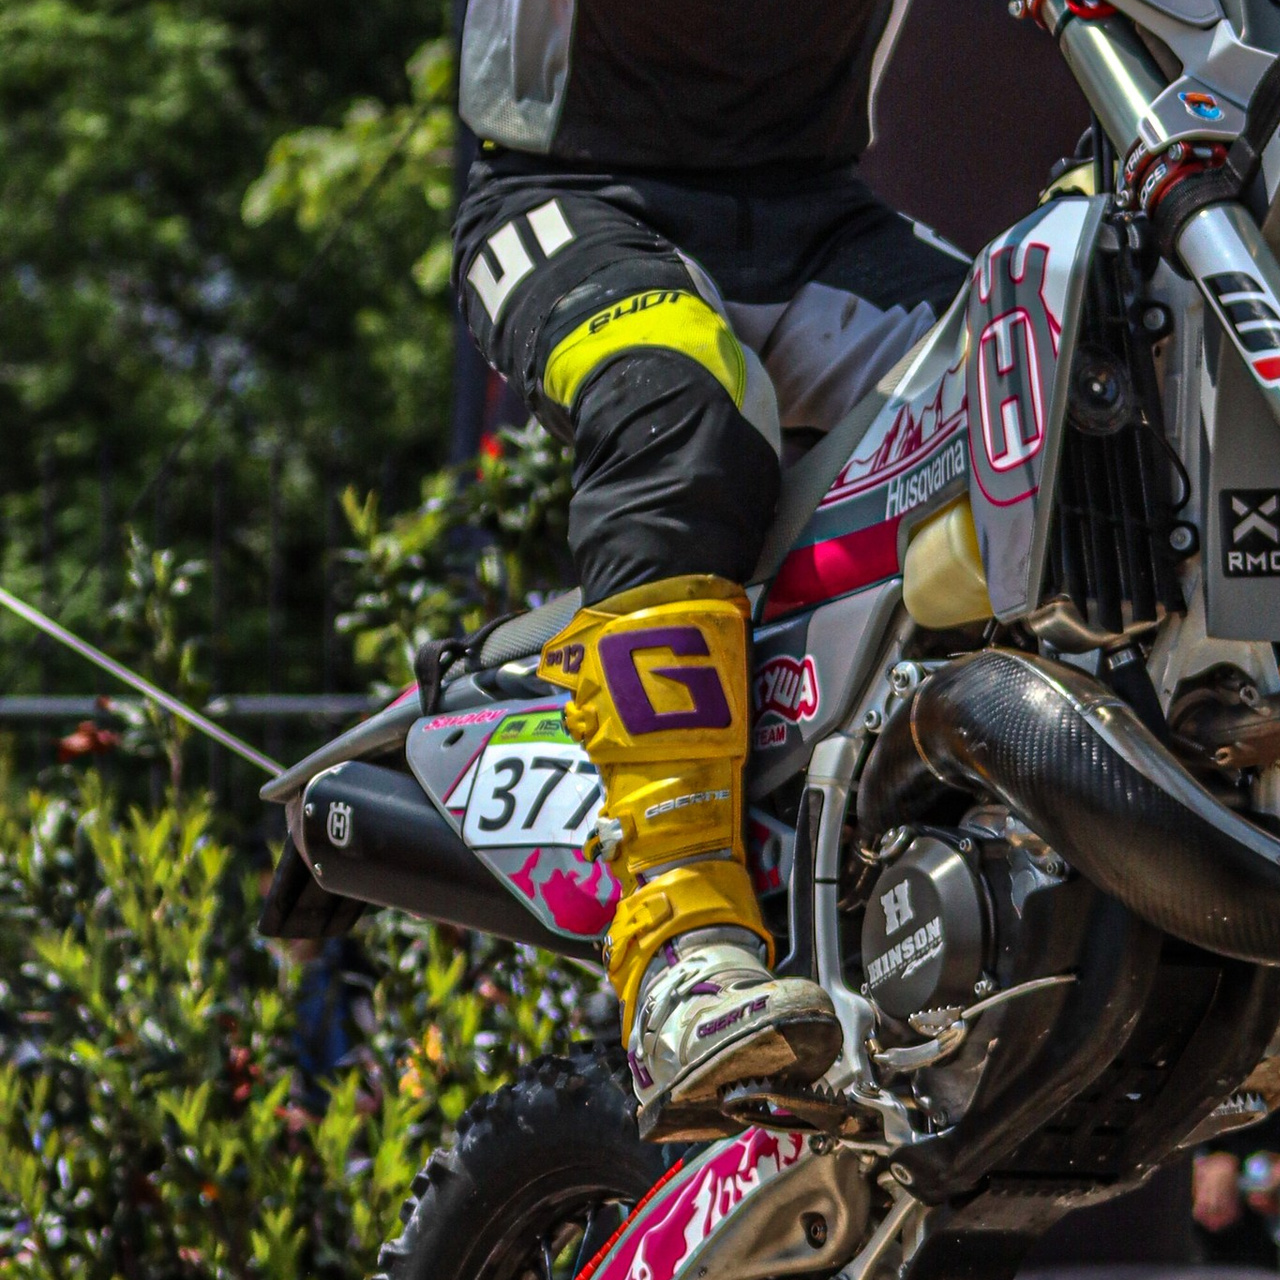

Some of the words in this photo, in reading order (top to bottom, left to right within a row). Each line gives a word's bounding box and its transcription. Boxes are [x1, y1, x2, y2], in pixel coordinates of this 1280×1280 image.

[886, 439, 965, 521] Husqvarna
[598, 625, 732, 736] G
[477, 756, 602, 832] 377
[867, 916, 941, 985] HINSON
